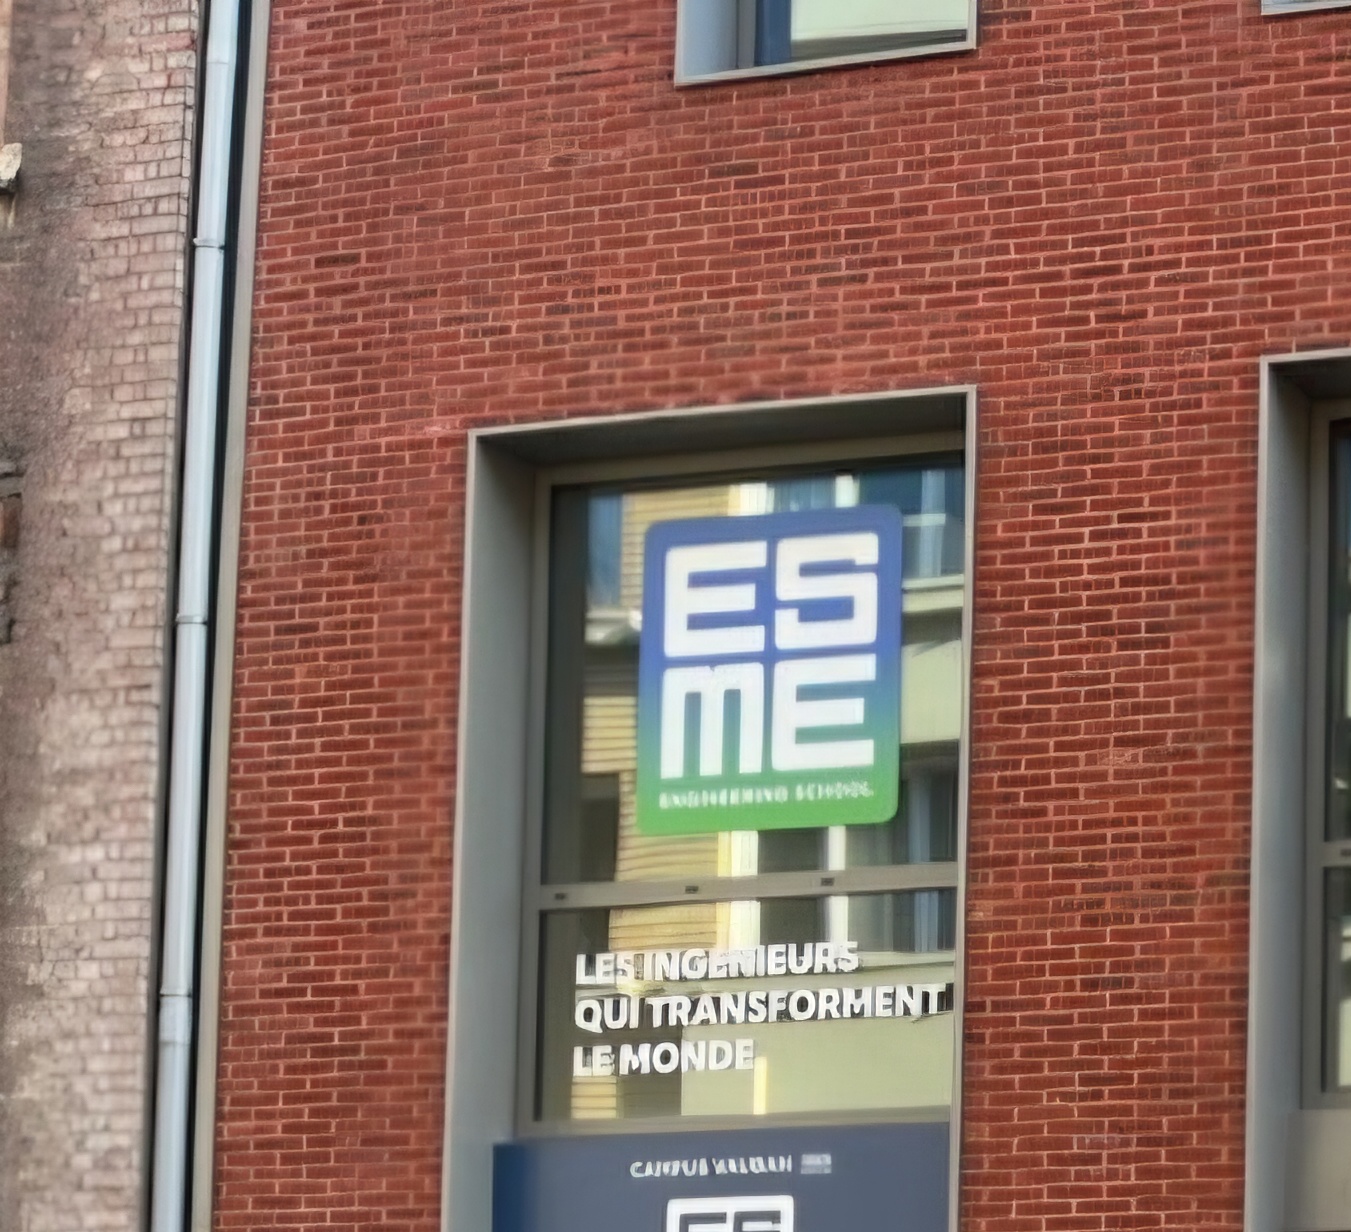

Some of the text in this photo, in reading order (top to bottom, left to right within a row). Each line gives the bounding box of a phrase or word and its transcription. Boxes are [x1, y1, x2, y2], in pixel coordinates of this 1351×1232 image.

[575, 952, 636, 985] LES
[574, 983, 946, 1033] QUI TRANSFORMENT
[573, 1038, 755, 1077] LE MONDE
